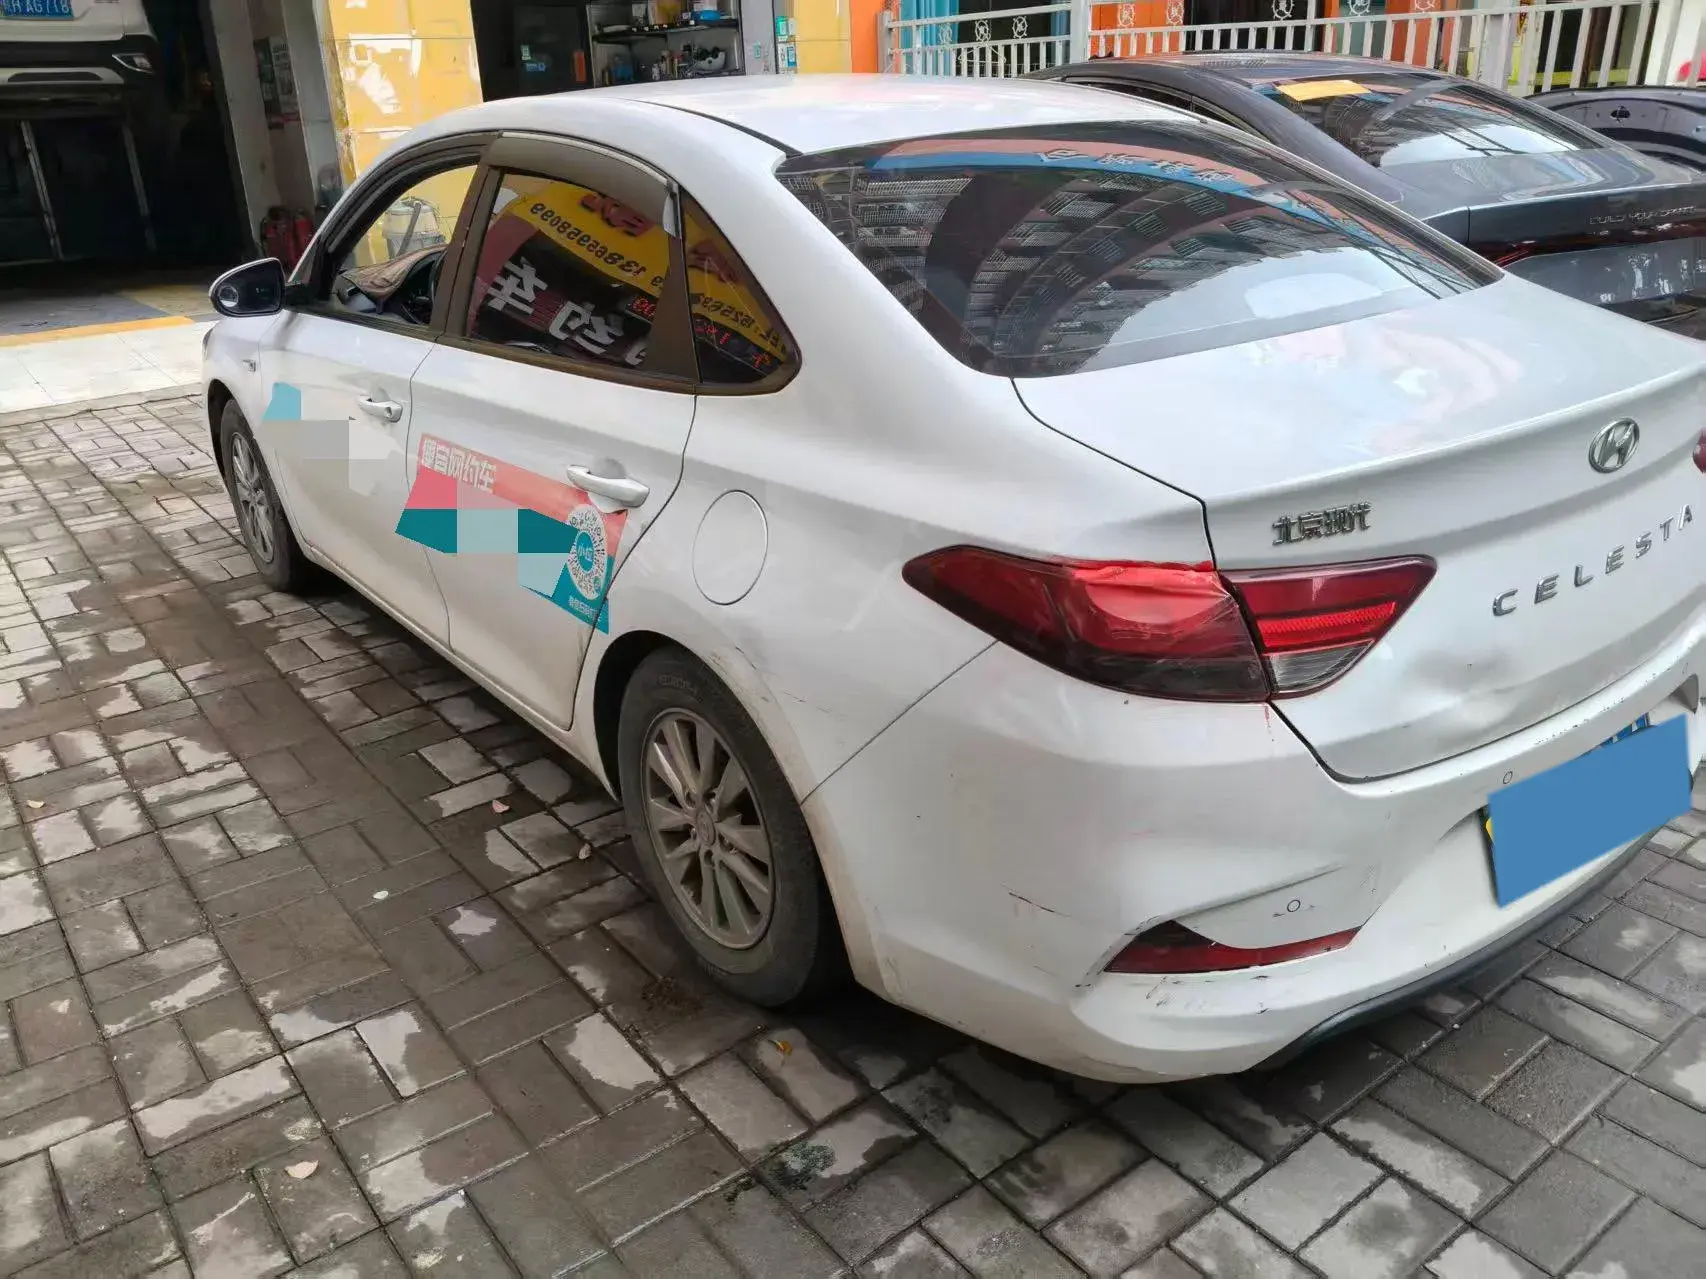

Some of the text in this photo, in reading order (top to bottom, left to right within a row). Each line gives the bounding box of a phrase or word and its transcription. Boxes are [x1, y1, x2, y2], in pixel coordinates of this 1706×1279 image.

[1271, 502, 1373, 545] 北京现代
[1492, 504, 1693, 617] CELESTA
